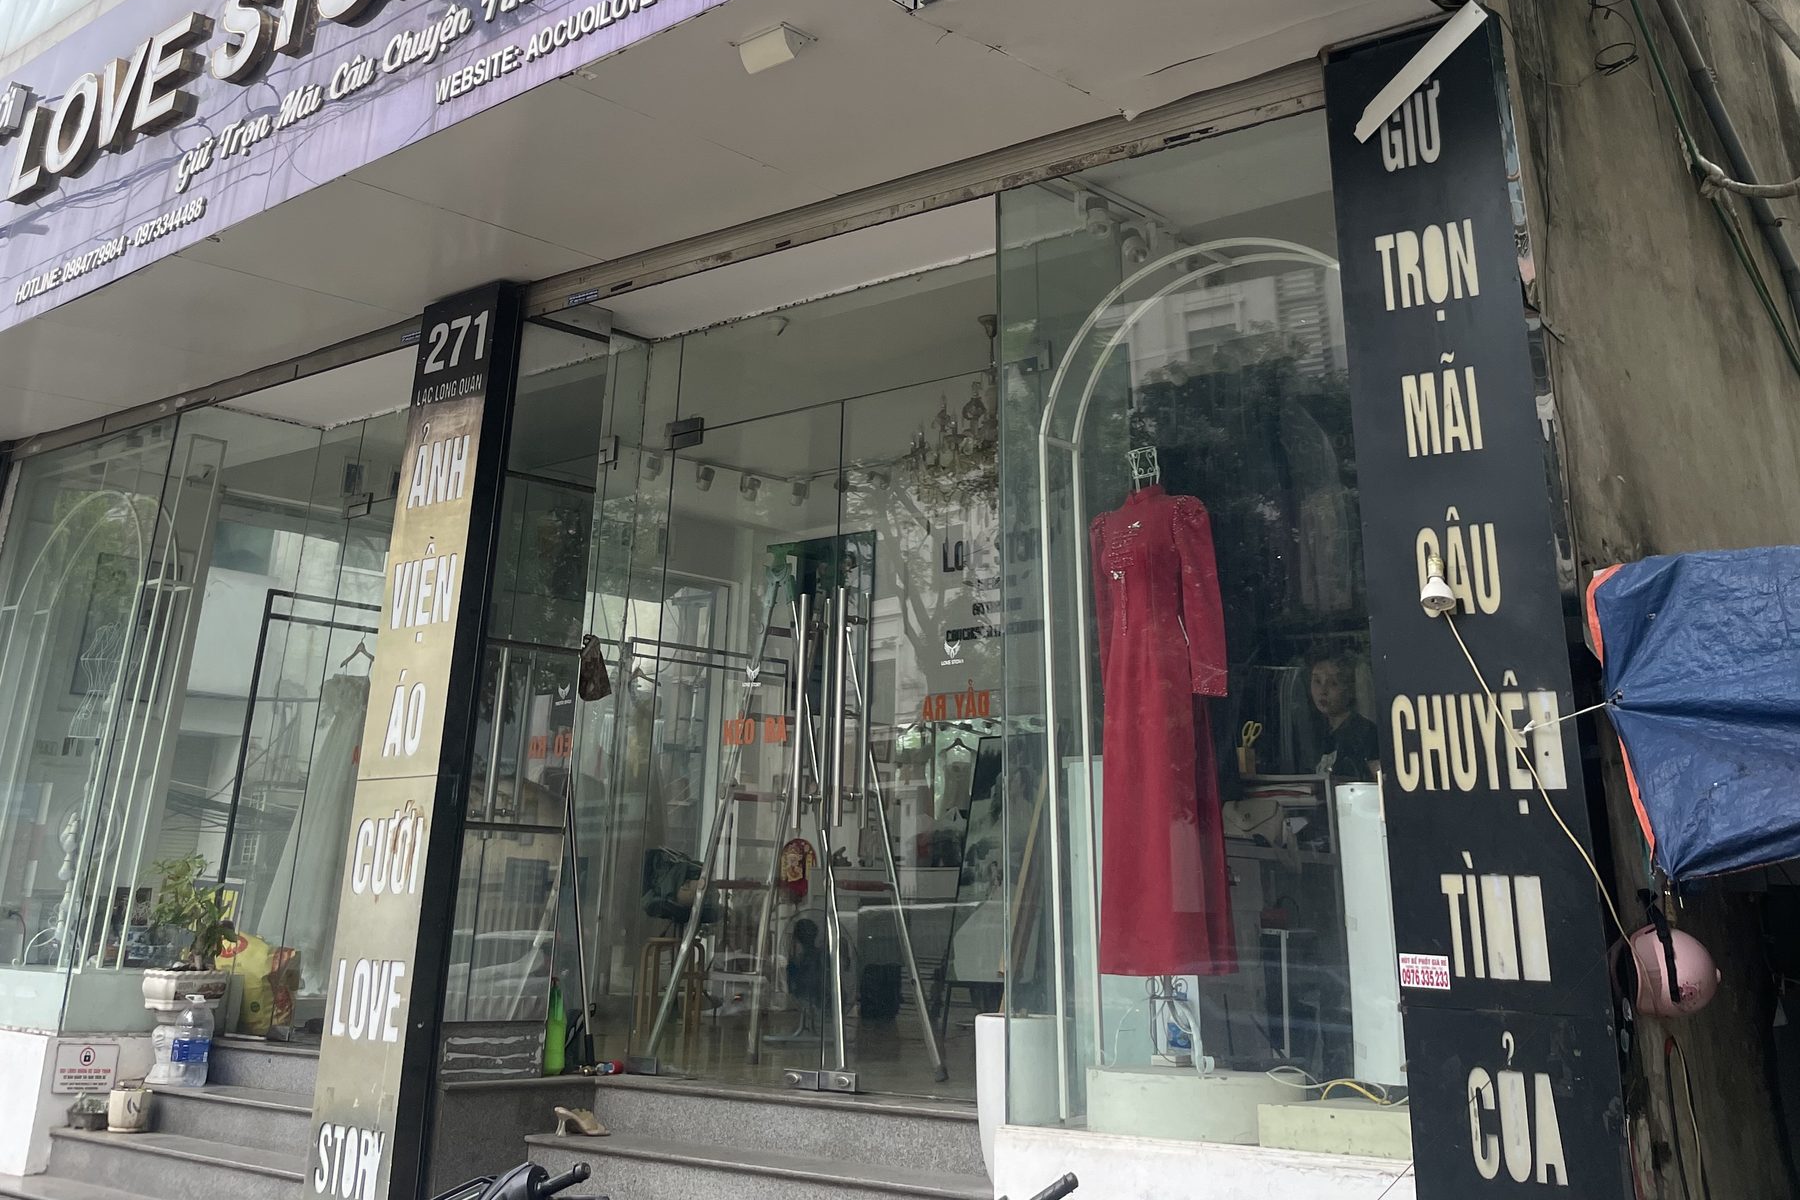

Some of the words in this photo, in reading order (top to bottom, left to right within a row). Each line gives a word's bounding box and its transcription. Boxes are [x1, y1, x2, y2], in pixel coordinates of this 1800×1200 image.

[9, 12, 207, 202] LOVE
[219, 114, 272, 160] Trọn
[330, 54, 375, 102] Câu
[382, 4, 472, 74] Chuyện
[435, 46, 521, 104] WEBSITE:
[14, 269, 62, 305] HOTLINE:
[62, 235, 127, 282] 0984779984
[1374, 218, 1480, 322] TRỌN
[423, 310, 489, 375] 271
[434, 380, 457, 402] LONG
[1401, 351, 1483, 458] MÃI
[407, 422, 470, 510] ẢNH
[390, 541, 458, 643] VIỆN
[1415, 505, 1502, 619] CÂU
[382, 669, 427, 758] ÁO
[764, 714, 787, 745] RA
[351, 800, 424, 896] CƯỚI
[330, 957, 406, 1044] LOVE
[1467, 1031, 1568, 1186] CỦA
[314, 1122, 386, 1200] STORY
